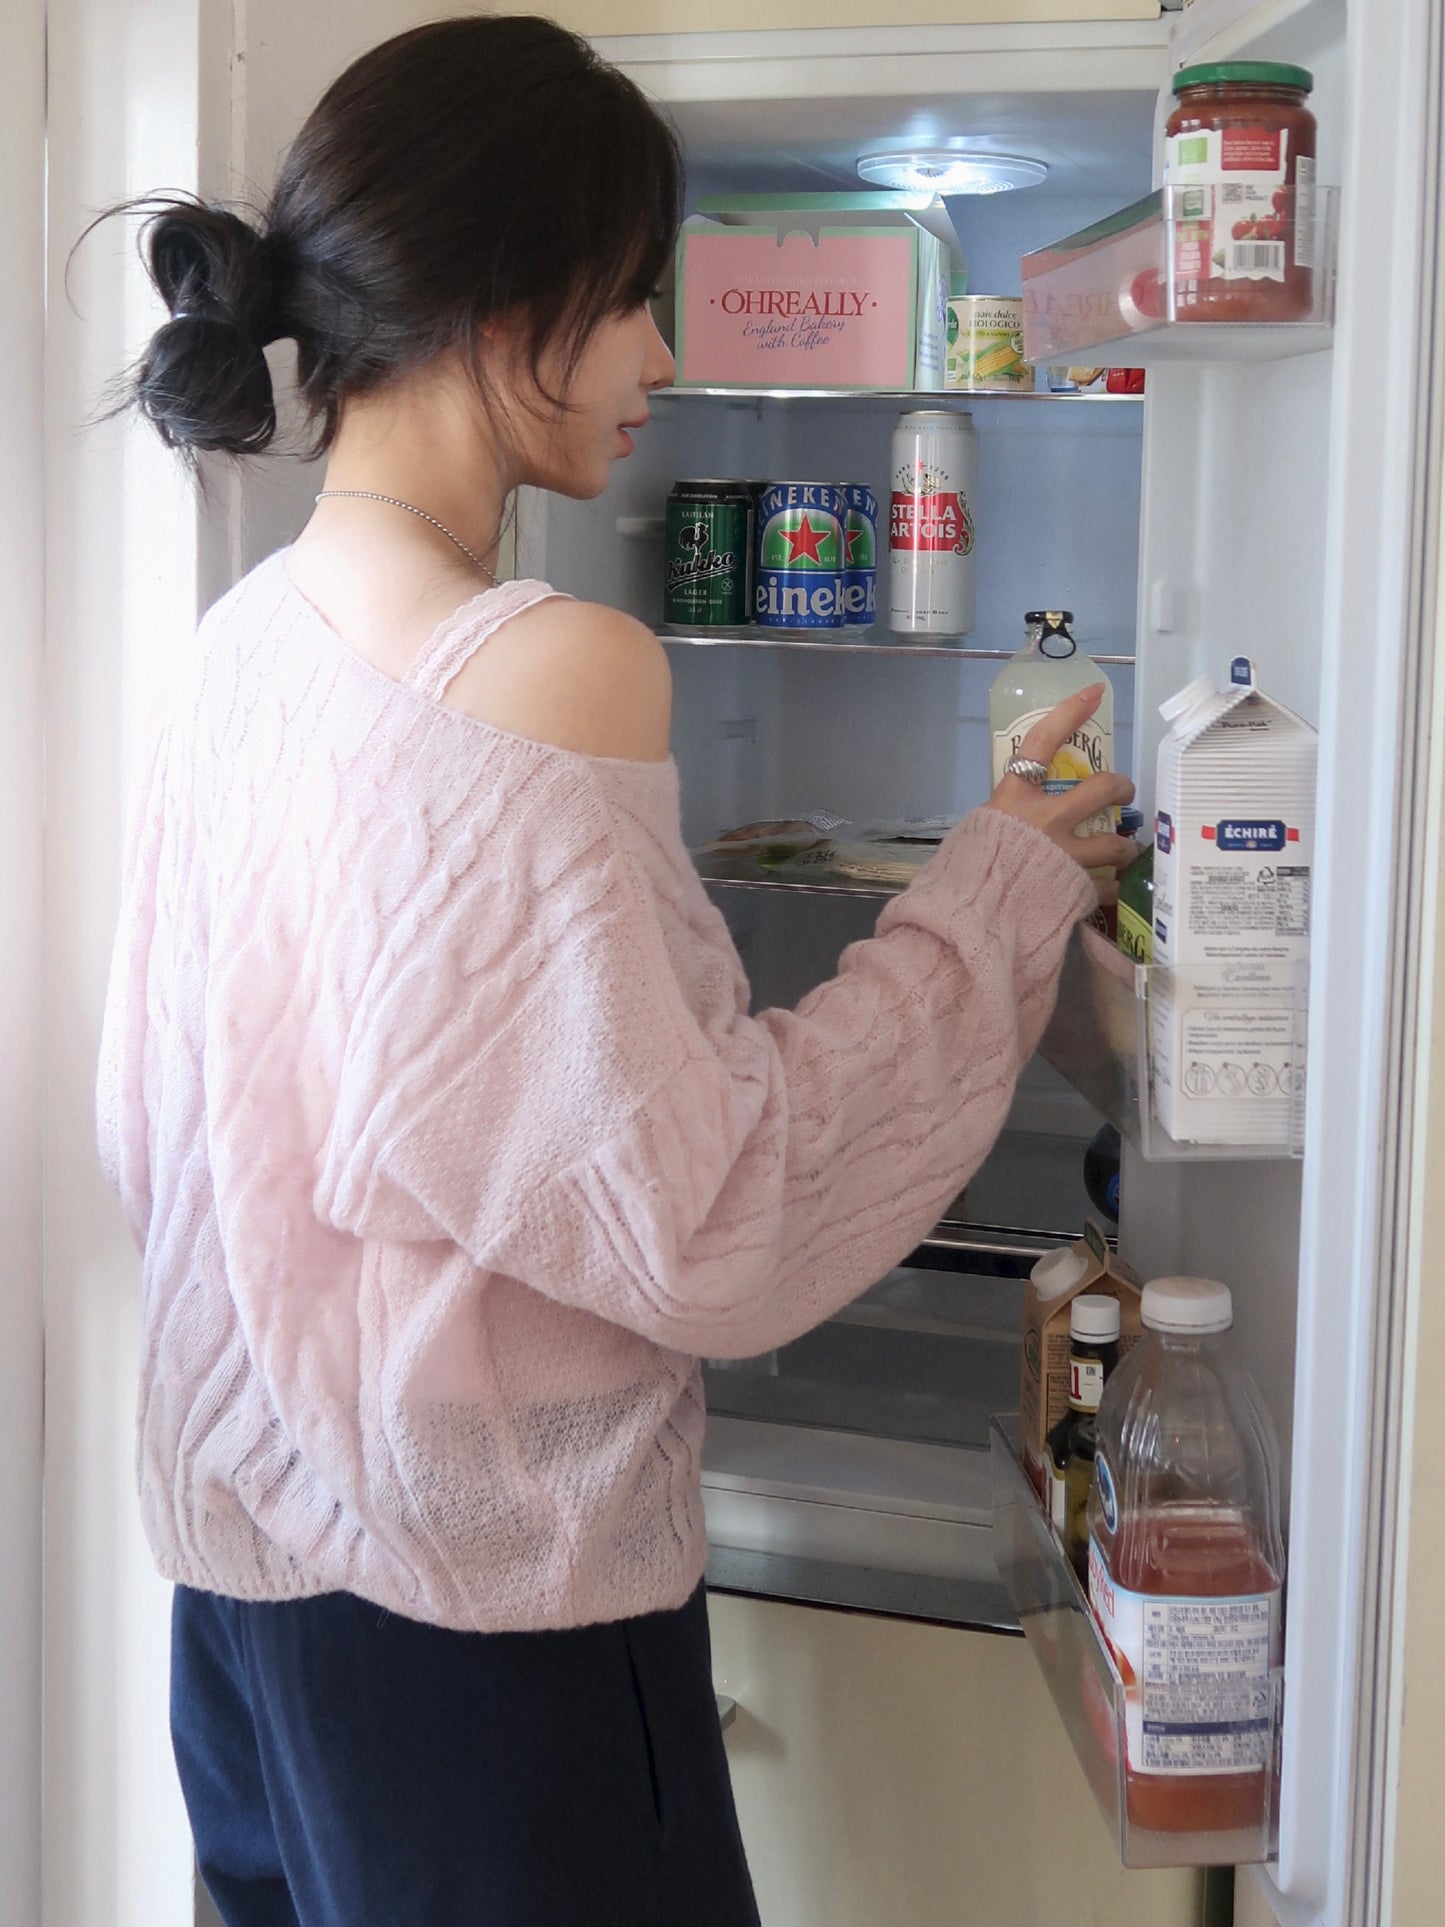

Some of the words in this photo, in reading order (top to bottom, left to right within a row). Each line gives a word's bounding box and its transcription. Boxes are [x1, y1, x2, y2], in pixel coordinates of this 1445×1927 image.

[722, 289, 870, 318] OHREALLY
[994, 309, 1018, 320] dolce
[743, 317, 797, 337] England
[800, 315, 846, 334] Bakery
[757, 335, 786, 350] with
[791, 331, 831, 351] Coffee
[892, 504, 957, 521] STELLA
[890, 522, 957, 539] ARTOIS
[667, 549, 736, 581] Kukko
[1224, 824, 1278, 839] ÉCHIRÉ
